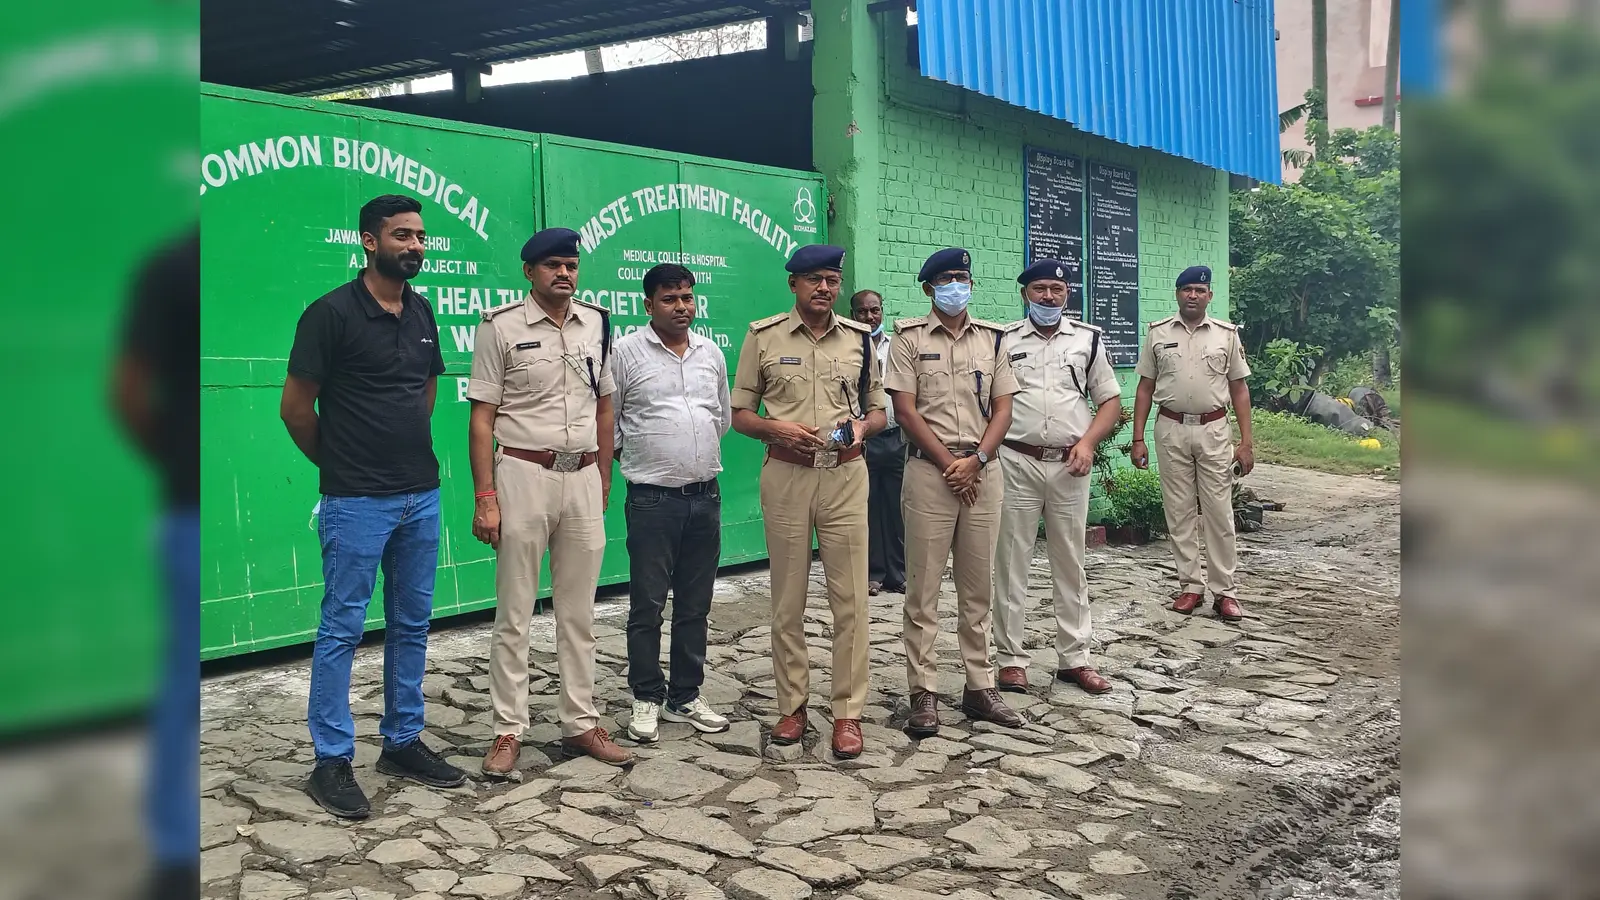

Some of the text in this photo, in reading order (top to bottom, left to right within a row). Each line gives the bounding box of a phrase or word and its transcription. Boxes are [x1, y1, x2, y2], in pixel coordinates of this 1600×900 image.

[200, 135, 490, 241] OMMON BIOMEDICAL
[580, 183, 798, 259] WASTE TREATMENT FACILITY
[466, 261, 477, 275] IN
[623, 249, 656, 263] MEDICAL
[658, 251, 690, 265] COLLEGE
[697, 254, 728, 268] HOSPITAL
